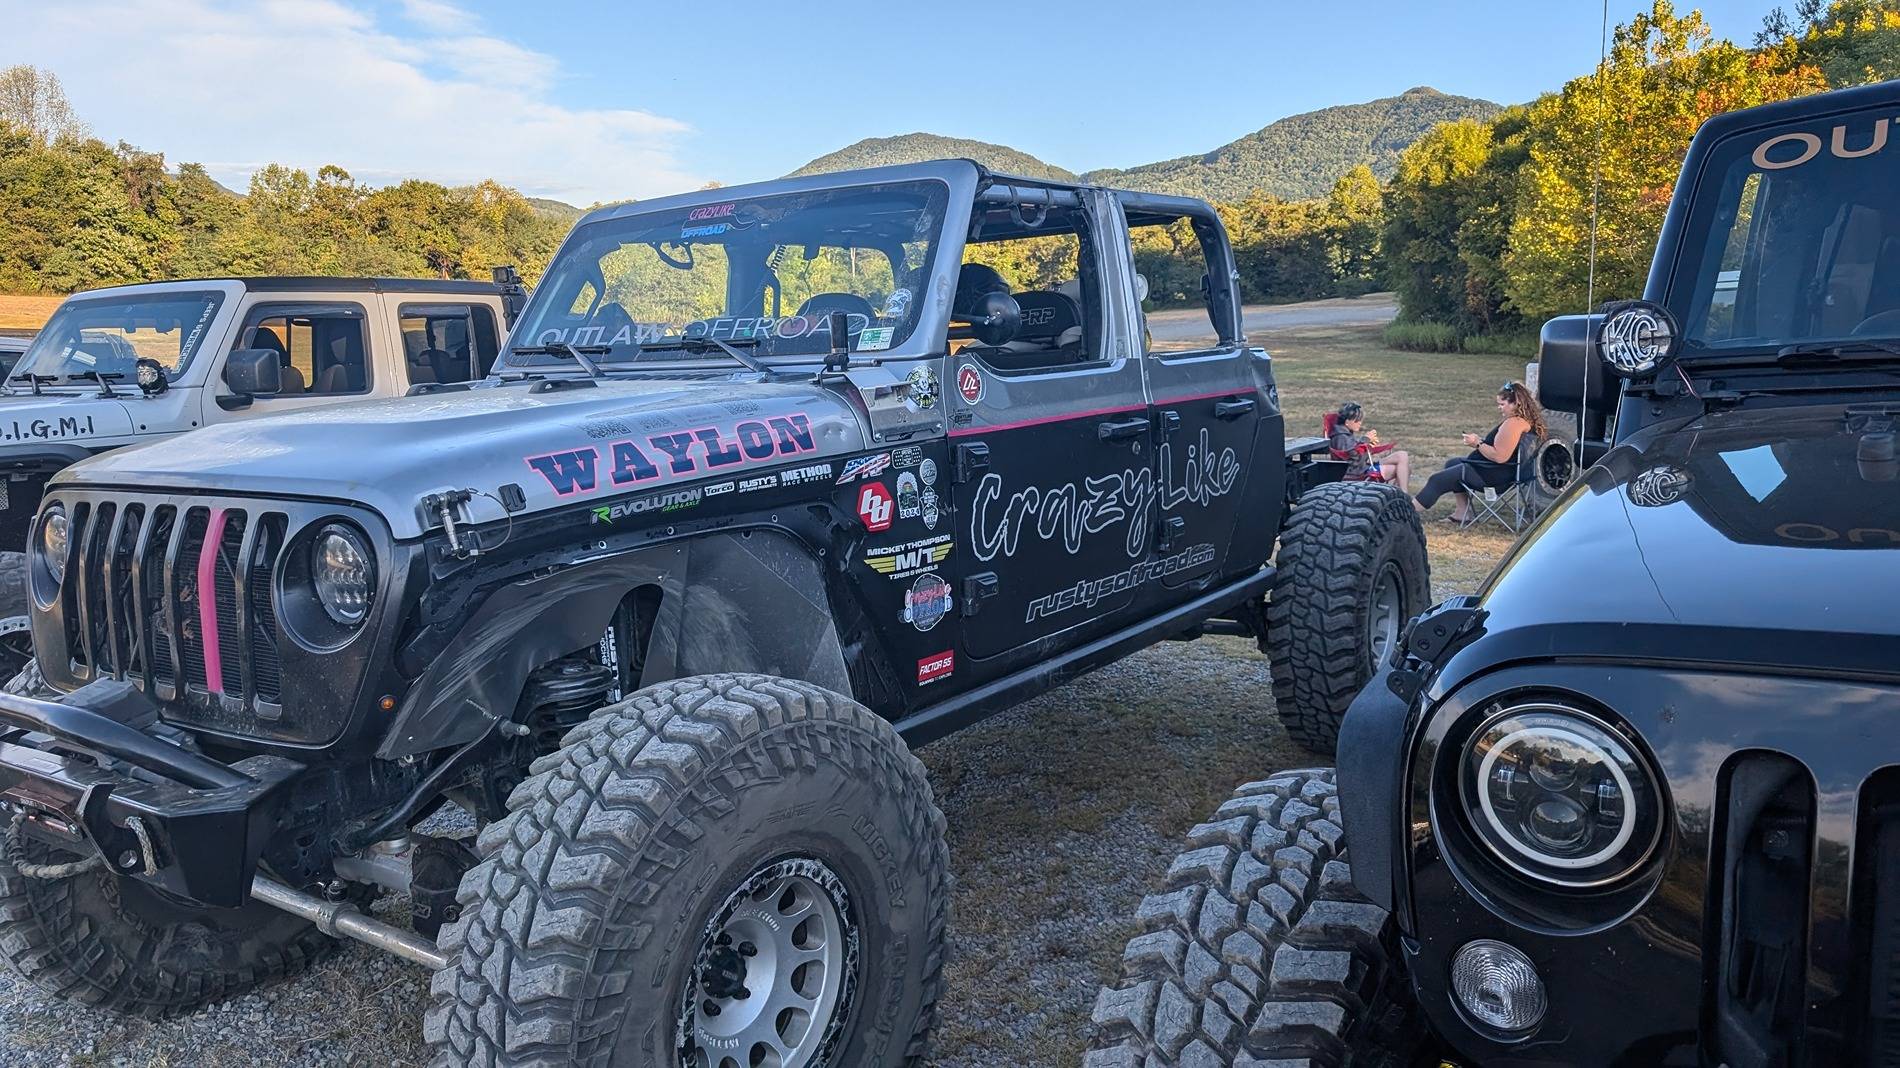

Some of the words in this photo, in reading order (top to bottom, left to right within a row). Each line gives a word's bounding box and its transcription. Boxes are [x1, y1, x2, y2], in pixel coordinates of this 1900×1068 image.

[1752, 117, 1900, 169] OU
[680, 223, 727, 239] OFFROAD
[1020, 307, 1056, 325] PRP
[536, 325, 669, 347] OUTLAW
[684, 313, 870, 340] OFFROAD
[1605, 311, 1658, 368] KC
[524, 412, 817, 496] WAYLON
[739, 475, 777, 489] RUSTY'S
[780, 464, 832, 482] METHOD
[804, 474, 833, 483] WHEELS
[705, 483, 734, 496] Torco
[591, 487, 702, 525] REVOLUTION
[861, 489, 892, 523] bd
[900, 507, 920, 518] 2024
[867, 543, 906, 556] MICKEY
[906, 534, 951, 550] THOMPSON
[895, 547, 936, 571] M/T
[889, 571, 910, 580] TIRES
[915, 564, 939, 575] WHEELS
[1025, 545, 1215, 623] rustysoffroad.com
[919, 659, 942, 675] FACTOR
